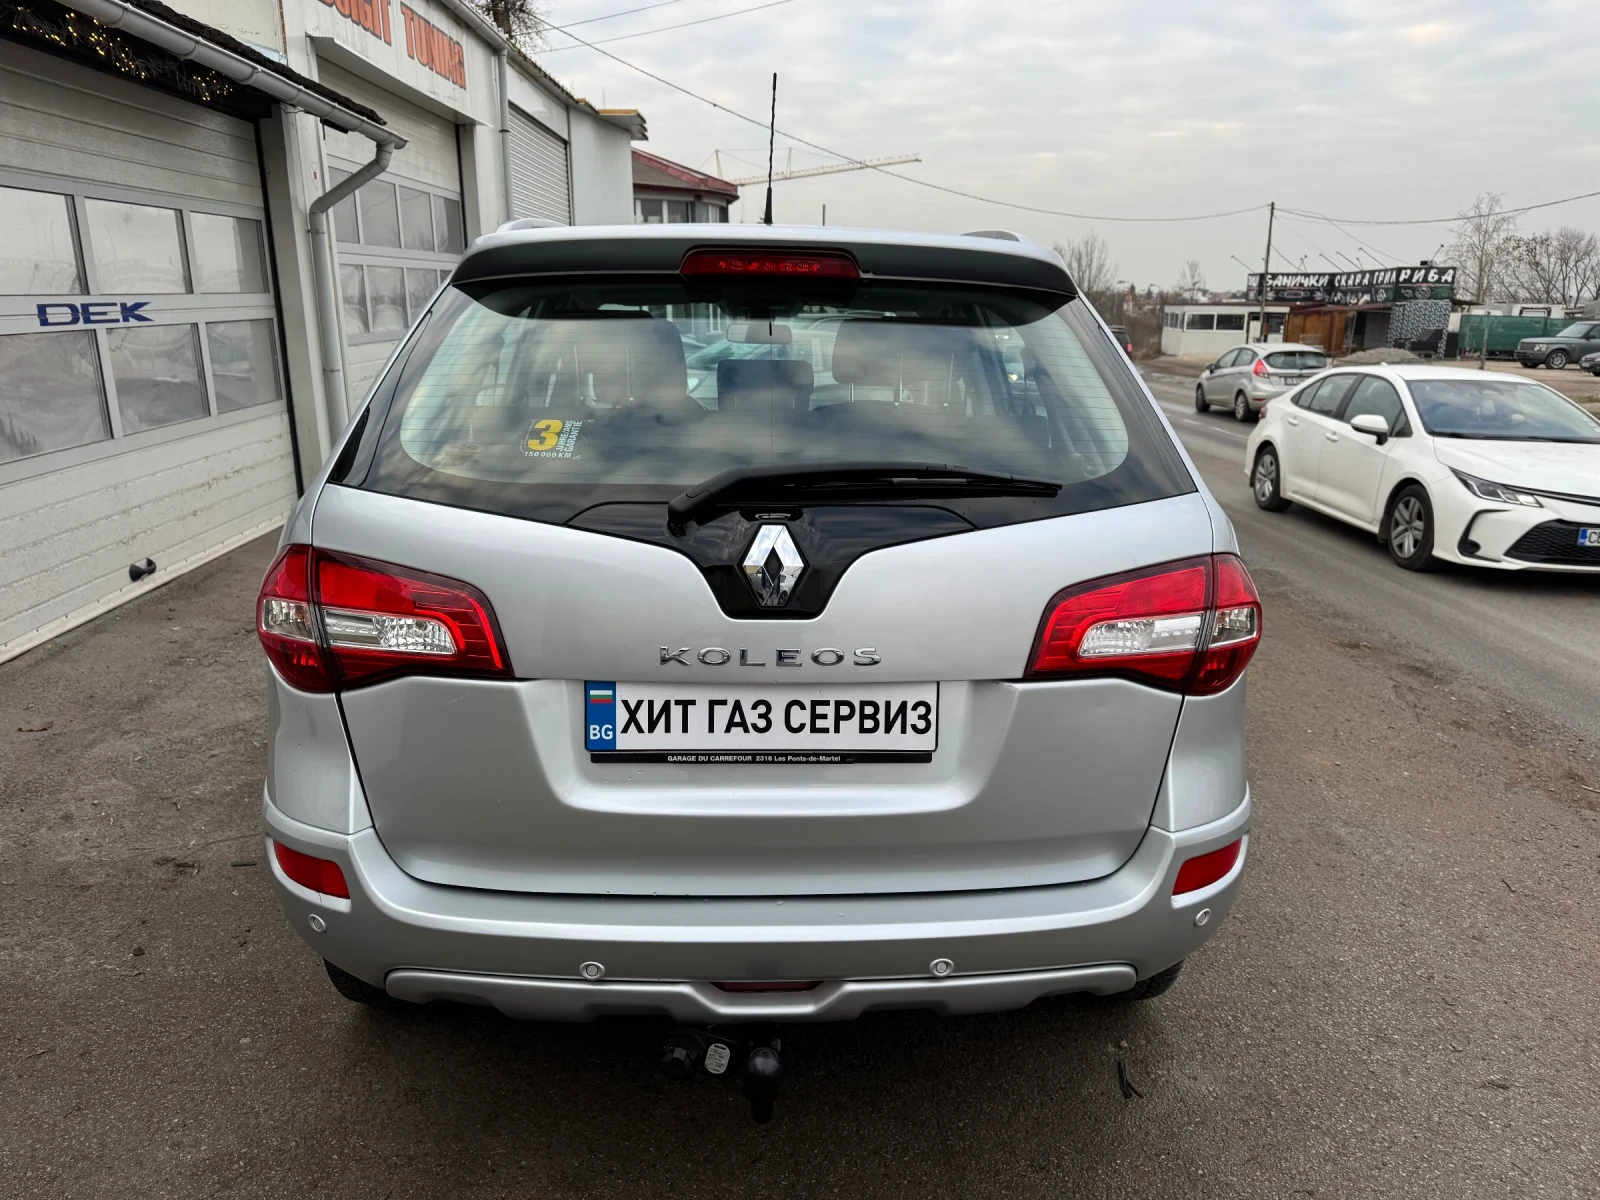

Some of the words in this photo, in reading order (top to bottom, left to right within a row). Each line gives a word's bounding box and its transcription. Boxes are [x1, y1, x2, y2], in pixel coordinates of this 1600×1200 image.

[400, 3, 467, 91] TUNING
[1334, 272, 1371, 288] СКАРА
[1373, 270, 1397, 285] ГРИЛ
[1399, 268, 1455, 283] РИБА
[36, 301, 155, 327] DEK
[527, 419, 563, 451] 3
[564, 420, 583, 452] GARANTIE
[659, 645, 882, 667] KOLEOS
[620, 699, 697, 734] ХИТ
[708, 699, 773, 734] ГАЗ
[784, 699, 932, 735] СЕРВИЗ
[589, 724, 614, 740] BG
